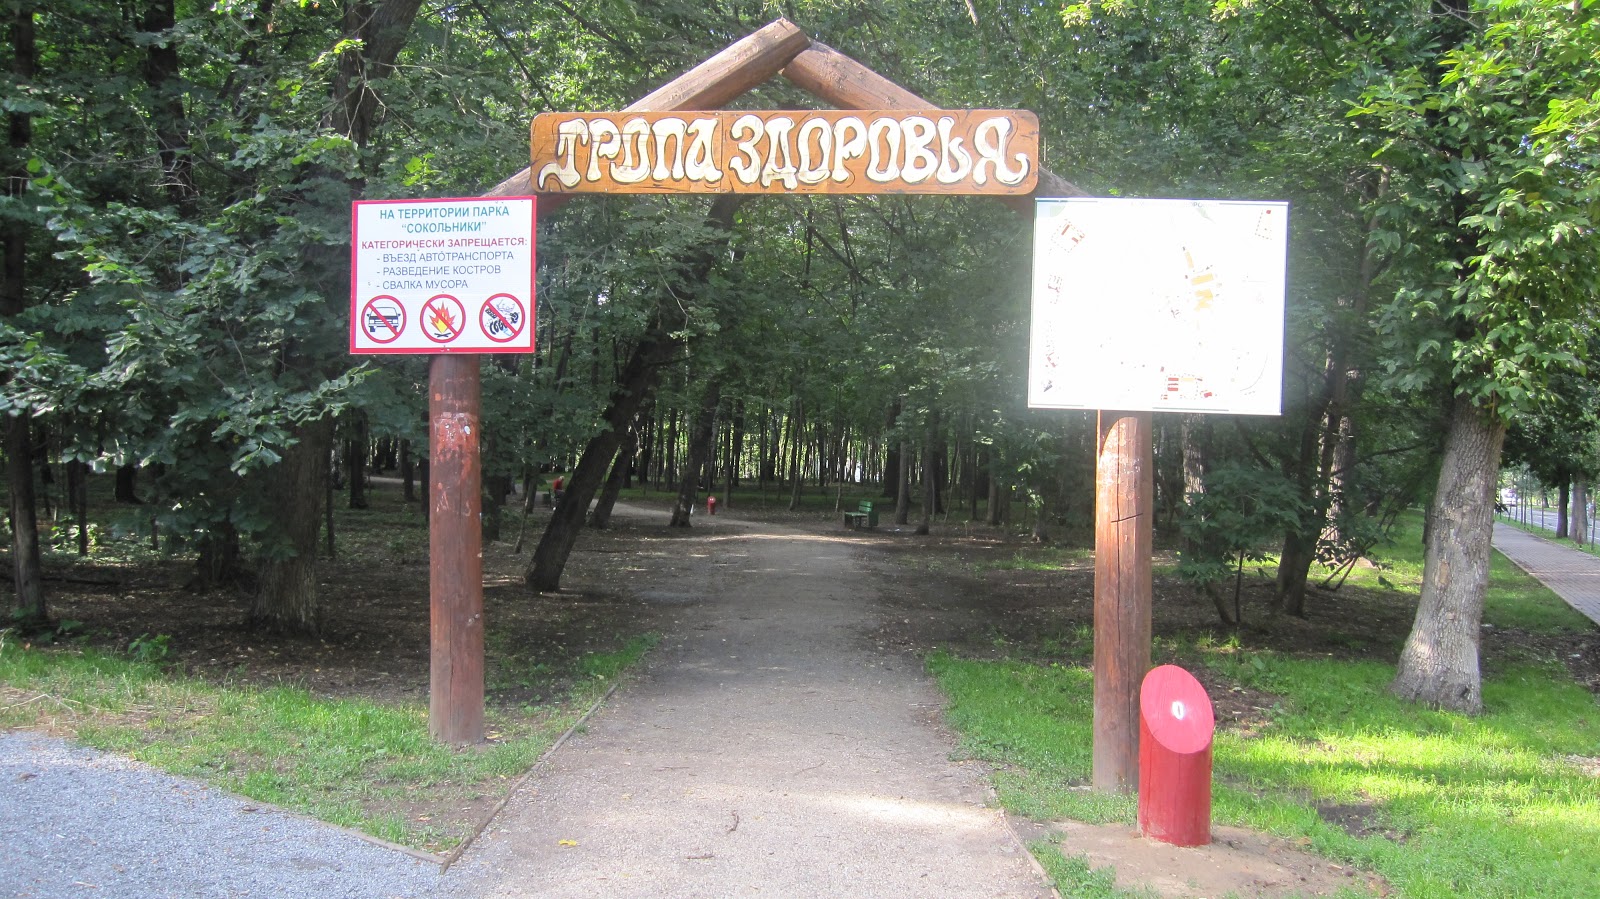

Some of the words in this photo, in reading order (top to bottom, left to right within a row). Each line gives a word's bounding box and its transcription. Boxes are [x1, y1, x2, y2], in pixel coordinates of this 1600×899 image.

[537, 117, 723, 190] ТРОПА
[729, 114, 1030, 190] ЗДОРОВЬЯ
[379, 209, 395, 220] НА
[398, 207, 470, 219] ТЕРРИТОРИИ
[472, 206, 510, 217] ПАРКА
[361, 239, 445, 249] КАТЕГОРИЧЕСКИ
[447, 237, 528, 248] ЗАПРЕЩАЕТСЯ:
[382, 253, 417, 264] ВЪЕЗД
[419, 251, 514, 262] АВТОТРАНСПОРТА
[382, 265, 450, 277] РАЗВЕДЕНИЕ
[452, 264, 502, 275] КОСТРОВ
[382, 280, 423, 290] СВАЛКА
[425, 279, 469, 289] МУСОРА
